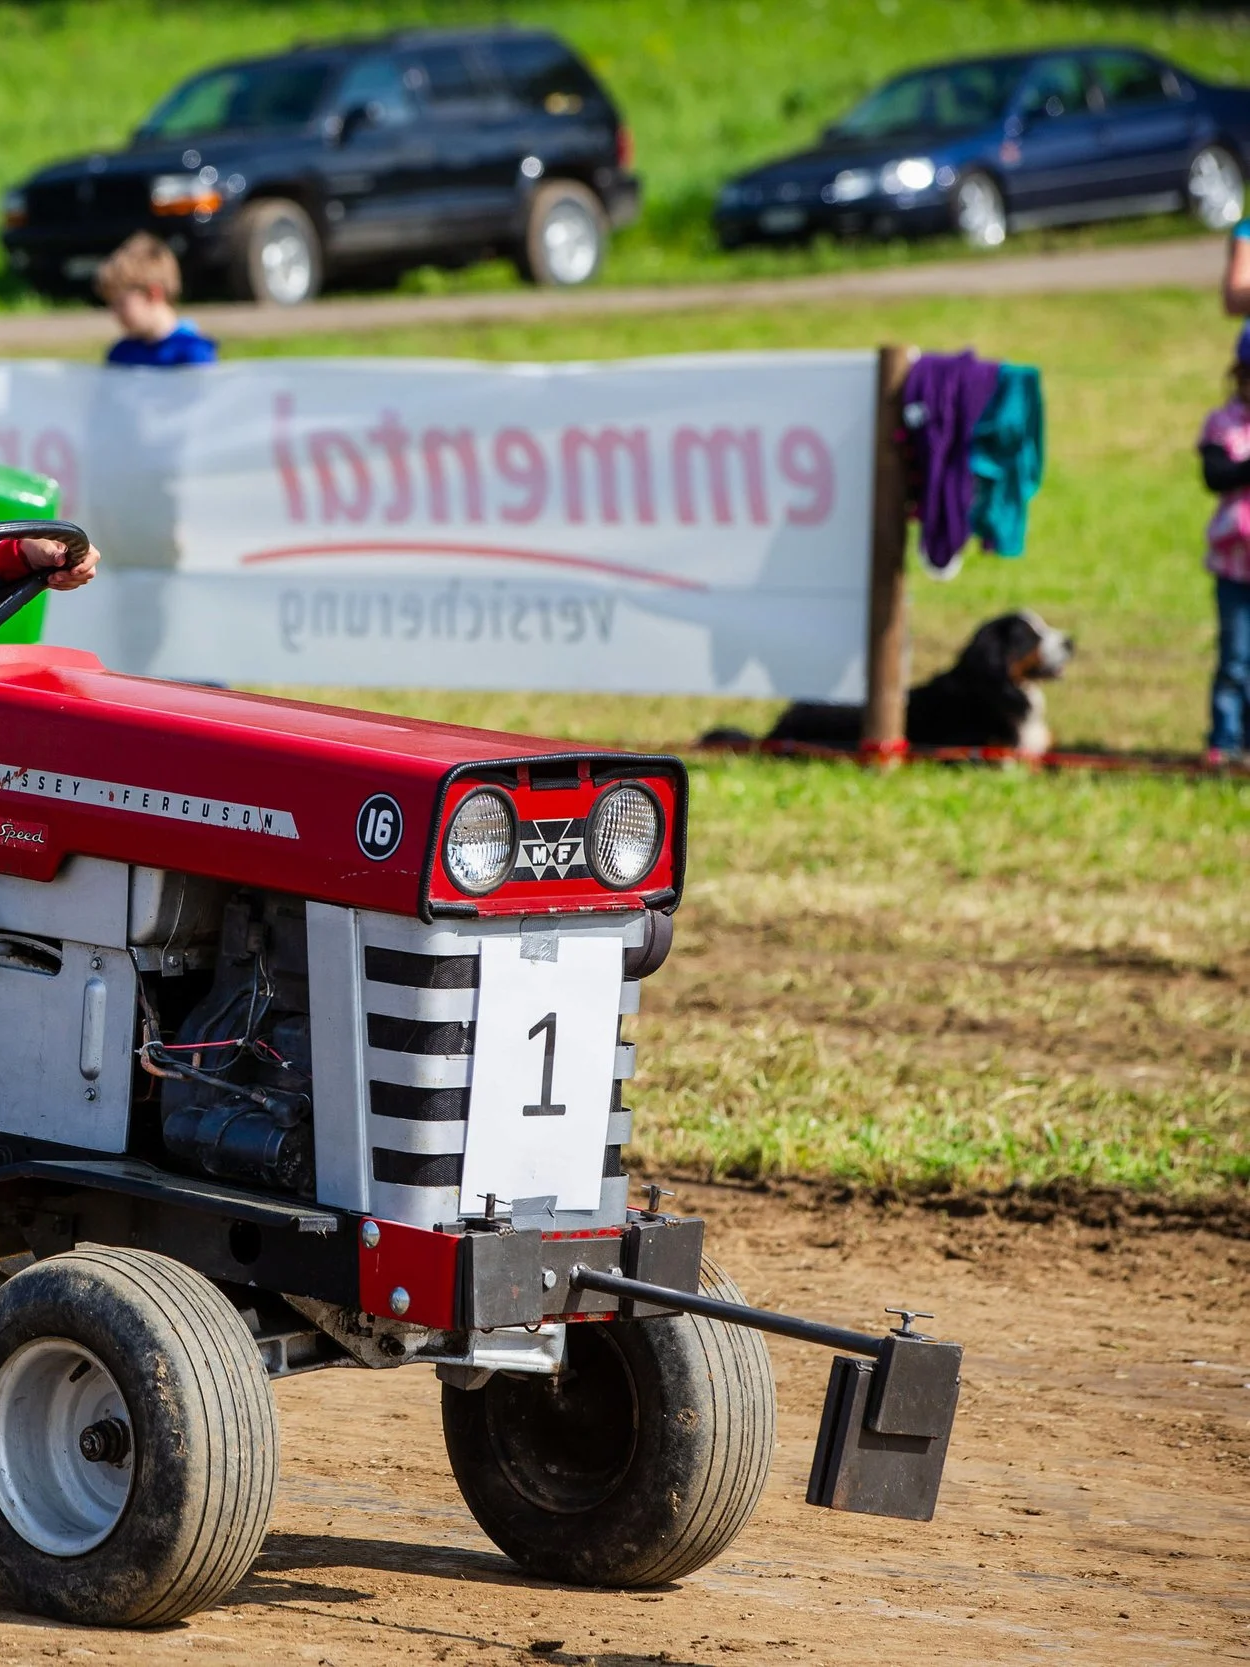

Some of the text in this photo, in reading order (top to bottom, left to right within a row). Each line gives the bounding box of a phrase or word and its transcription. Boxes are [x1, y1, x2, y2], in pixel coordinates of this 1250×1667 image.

[123, 790, 273, 829] FERGUSON
[364, 807, 394, 846] 16
[522, 1011, 566, 1117] 1
